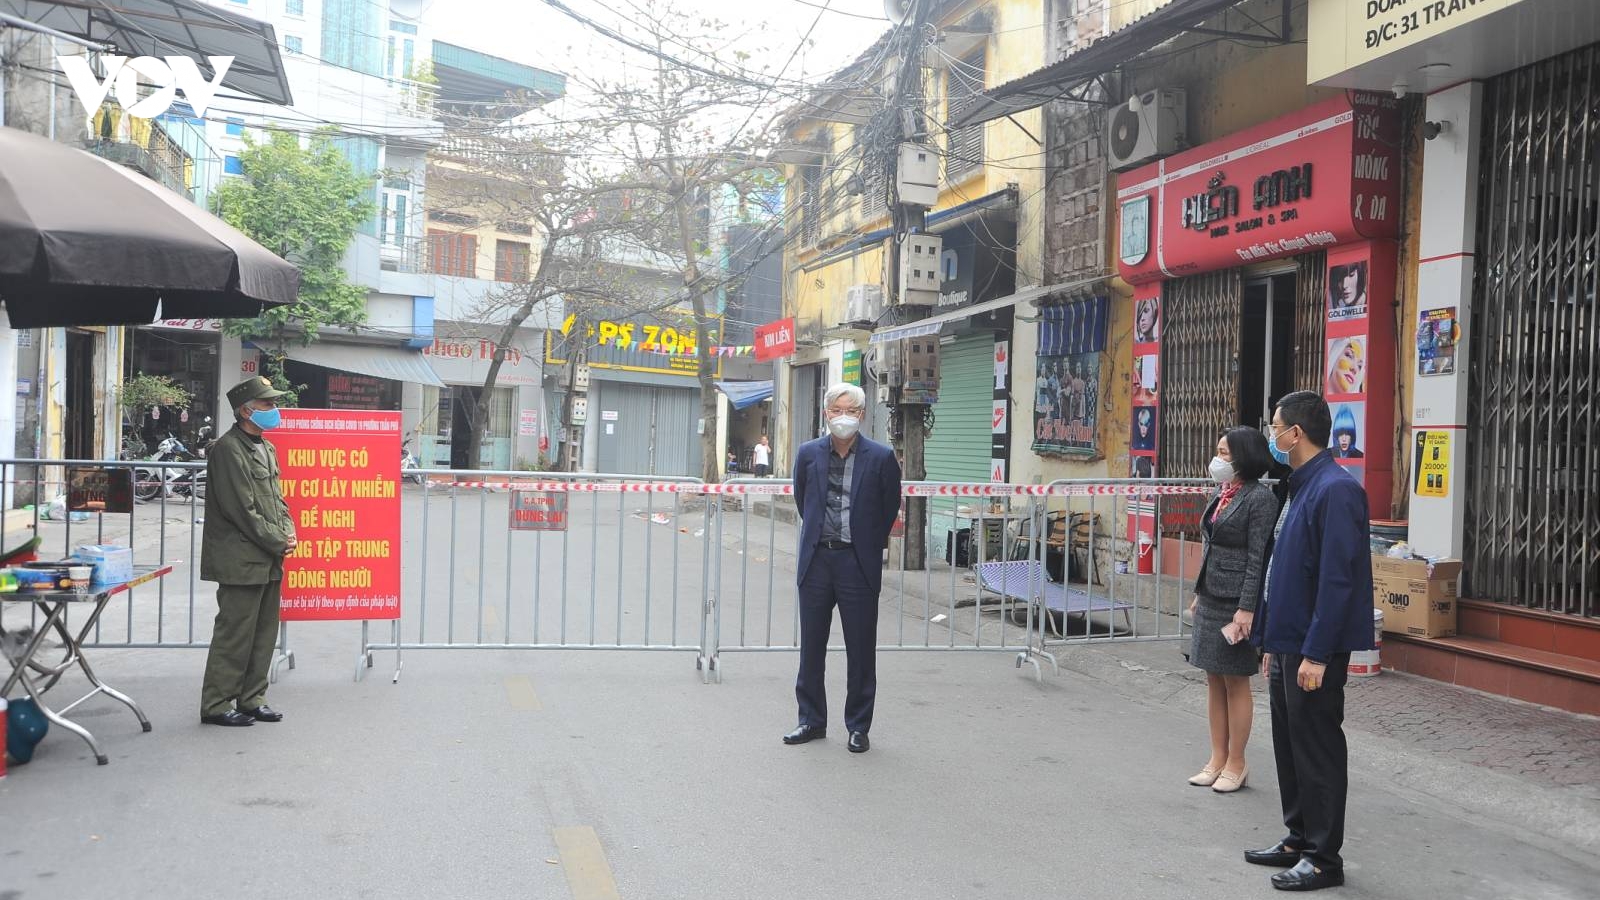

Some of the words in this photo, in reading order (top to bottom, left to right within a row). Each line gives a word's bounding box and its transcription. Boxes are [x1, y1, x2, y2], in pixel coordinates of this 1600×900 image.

[1367, 0, 1407, 19] DO
[1365, 22, 1397, 48] Đ/C:
[1401, 11, 1419, 34] 31
[1354, 148, 1389, 181] MÓNG
[1370, 195, 1386, 221] DA
[938, 290, 968, 306] Boutique
[1328, 307, 1364, 318] GOLDWELL
[643, 325, 697, 354] ZON
[764, 331, 775, 348] KIM
[775, 325, 790, 345] LIÊN
[242, 361, 255, 373] 30
[288, 449, 315, 467] KHU
[320, 448, 346, 471] VỰC
[350, 446, 368, 468] CÓ
[280, 480, 296, 497] UY
[301, 478, 319, 498] CƠ
[323, 476, 347, 497] LÂY
[351, 474, 396, 498] NHIỄM
[322, 510, 355, 532] NGHỊ
[316, 537, 341, 562] TẬP
[346, 541, 389, 558] TRUNG
[288, 566, 326, 588] ĐÔNG
[330, 566, 371, 588] NGƯỜI
[280, 596, 292, 611] hạm
[322, 595, 334, 608] theo
[335, 599, 345, 611] quy
[346, 595, 358, 610] định
[370, 595, 384, 611] pháp
[1389, 592, 1409, 607] OMO
